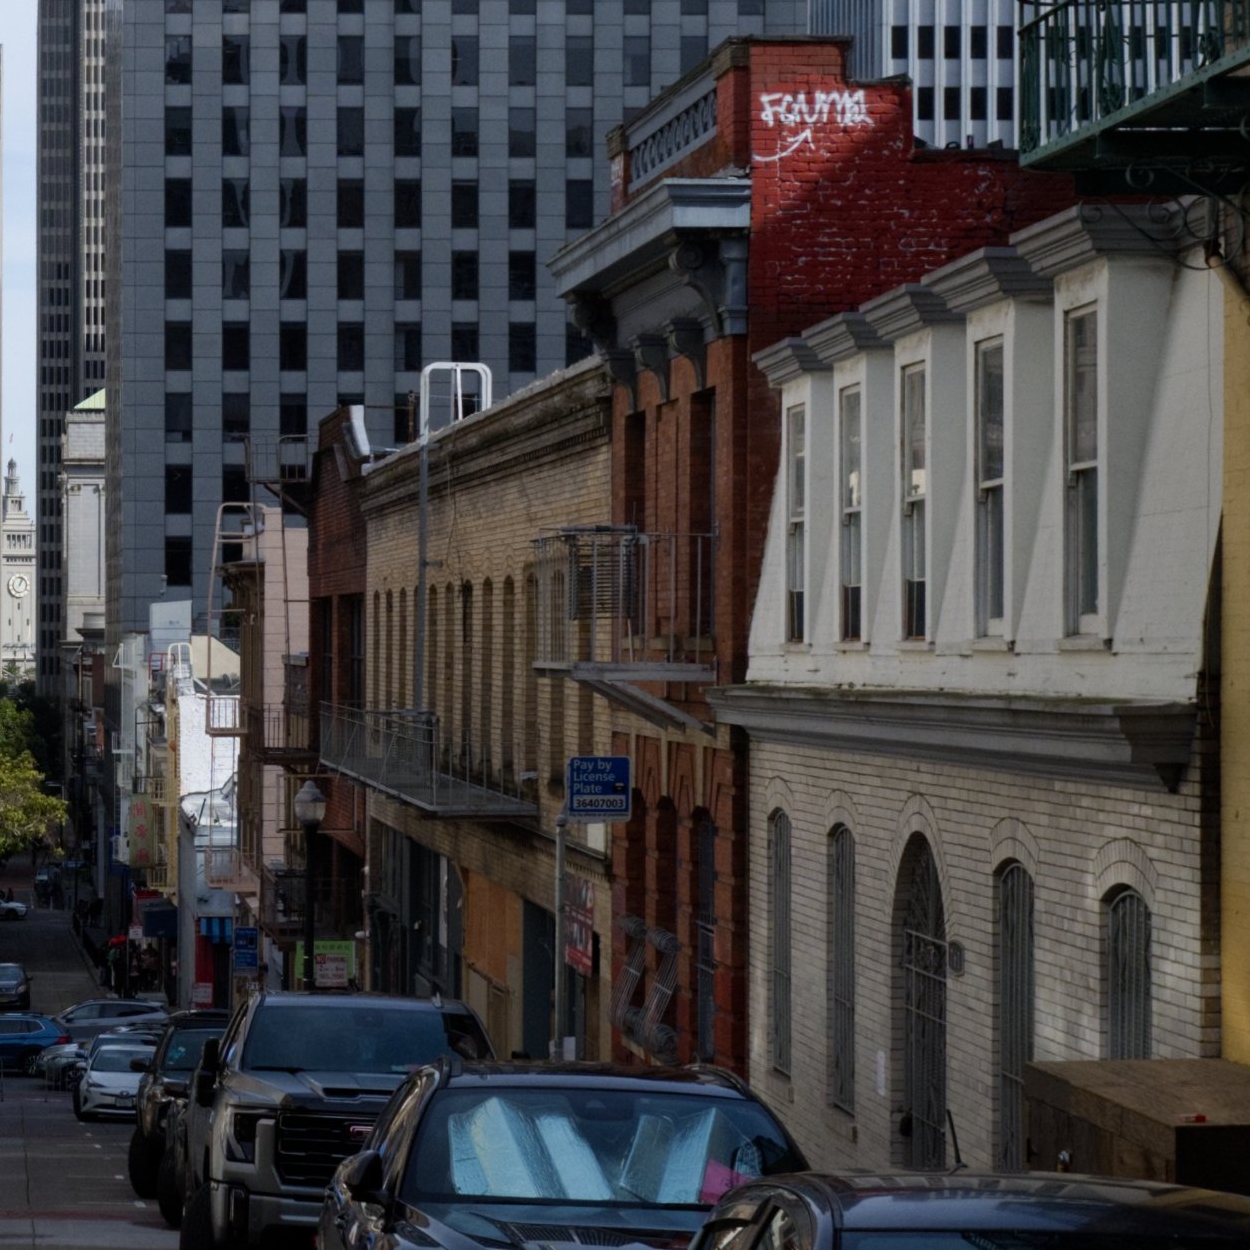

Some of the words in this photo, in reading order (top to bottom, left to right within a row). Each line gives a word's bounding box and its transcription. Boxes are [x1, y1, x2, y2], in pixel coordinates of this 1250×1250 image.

[573, 759, 595, 772] Pay
[597, 759, 612, 771] by
[573, 772, 616, 782] License
[573, 783, 603, 794] Plate
[575, 799, 624, 808] 36407003
